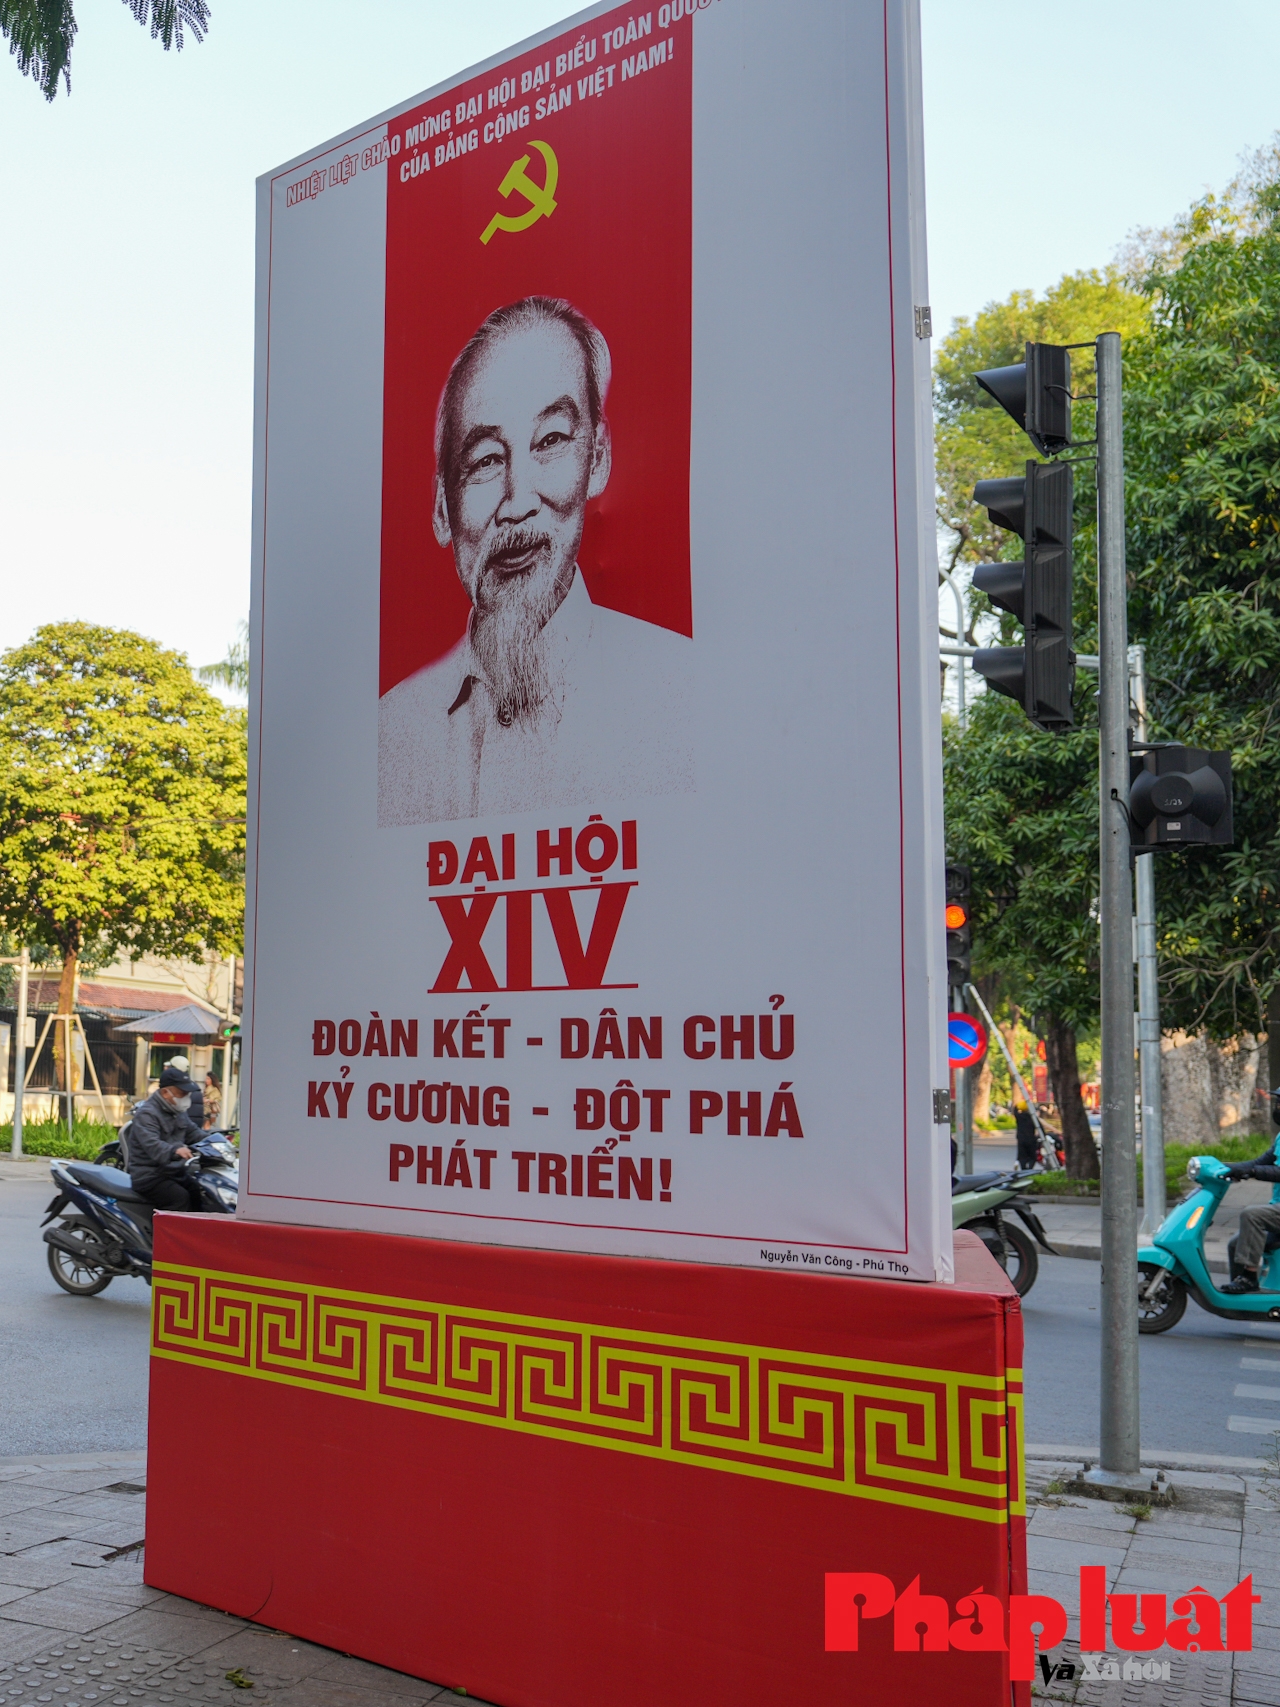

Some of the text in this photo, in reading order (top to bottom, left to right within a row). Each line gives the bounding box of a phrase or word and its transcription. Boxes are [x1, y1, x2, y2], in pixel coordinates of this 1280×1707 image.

[286, 170, 327, 208] NHIỆT
[329, 154, 359, 185] LIỆT
[361, 136, 401, 171] CHÀO
[405, 109, 451, 149] MỪNG
[455, 94, 483, 125] ĐẠI
[487, 77, 516, 110] HỘI
[521, 61, 550, 94] ĐẠI
[555, 35, 597, 78] BIỂU
[602, 12, 652, 55] TOÀN
[399, 37, 674, 183] CỦA ĐẢNG CỘNG SẢN VIỆT NAM!
[427, 814, 638, 892] ĐẠI HỘI
[427, 881, 639, 994] XIV
[312, 1011, 418, 1058] ĐOÀN
[433, 1004, 511, 1059] KẾT
[560, 1007, 663, 1060] DÂN
[683, 994, 795, 1060] CHỦ
[307, 1065, 355, 1119] KỶ
[367, 1079, 510, 1127] CƯƠNG
[573, 1079, 671, 1142] ĐỘT
[689, 1081, 804, 1138] PHÁ
[388, 1137, 672, 1203] PHÁT TRIỂN!
[760, 1249, 799, 1263] Nguyễn
[801, 1253, 821, 1265] Văn
[824, 1255, 853, 1270] Công
[863, 1258, 884, 1271] Phú
[887, 1261, 909, 1276] Thọ
